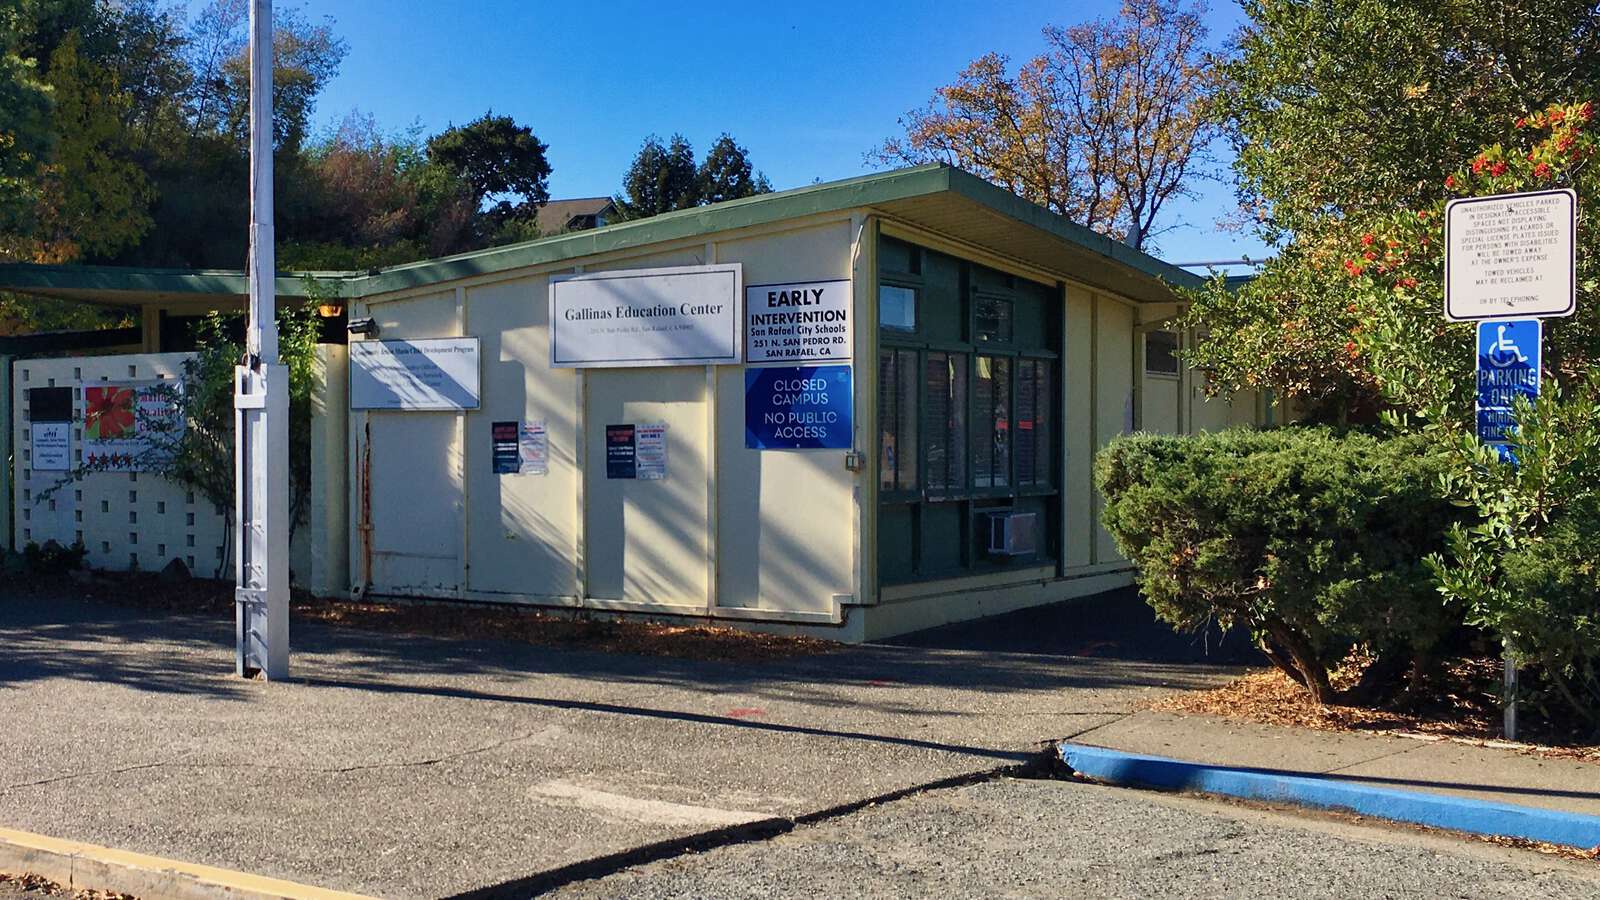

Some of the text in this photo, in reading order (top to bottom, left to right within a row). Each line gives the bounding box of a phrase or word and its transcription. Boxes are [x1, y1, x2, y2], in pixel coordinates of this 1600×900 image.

[1506, 200, 1533, 210] VEHICLES
[1512, 215, 1546, 224] DISPLAYING
[768, 288, 824, 308] EARLY
[564, 302, 724, 321] Gallinas Education Center
[751, 310, 846, 326] INTERVENTION
[751, 324, 846, 336] San Rafael City Schools
[753, 340, 768, 348] 251
[786, 348, 816, 357] RAFAEL,
[1480, 368, 1536, 386] PARKING
[774, 378, 827, 391] CLOSED
[772, 393, 829, 405] CAMPUS
[765, 411, 837, 424] NO PUBLIC
[774, 426, 827, 438] ACCESS
